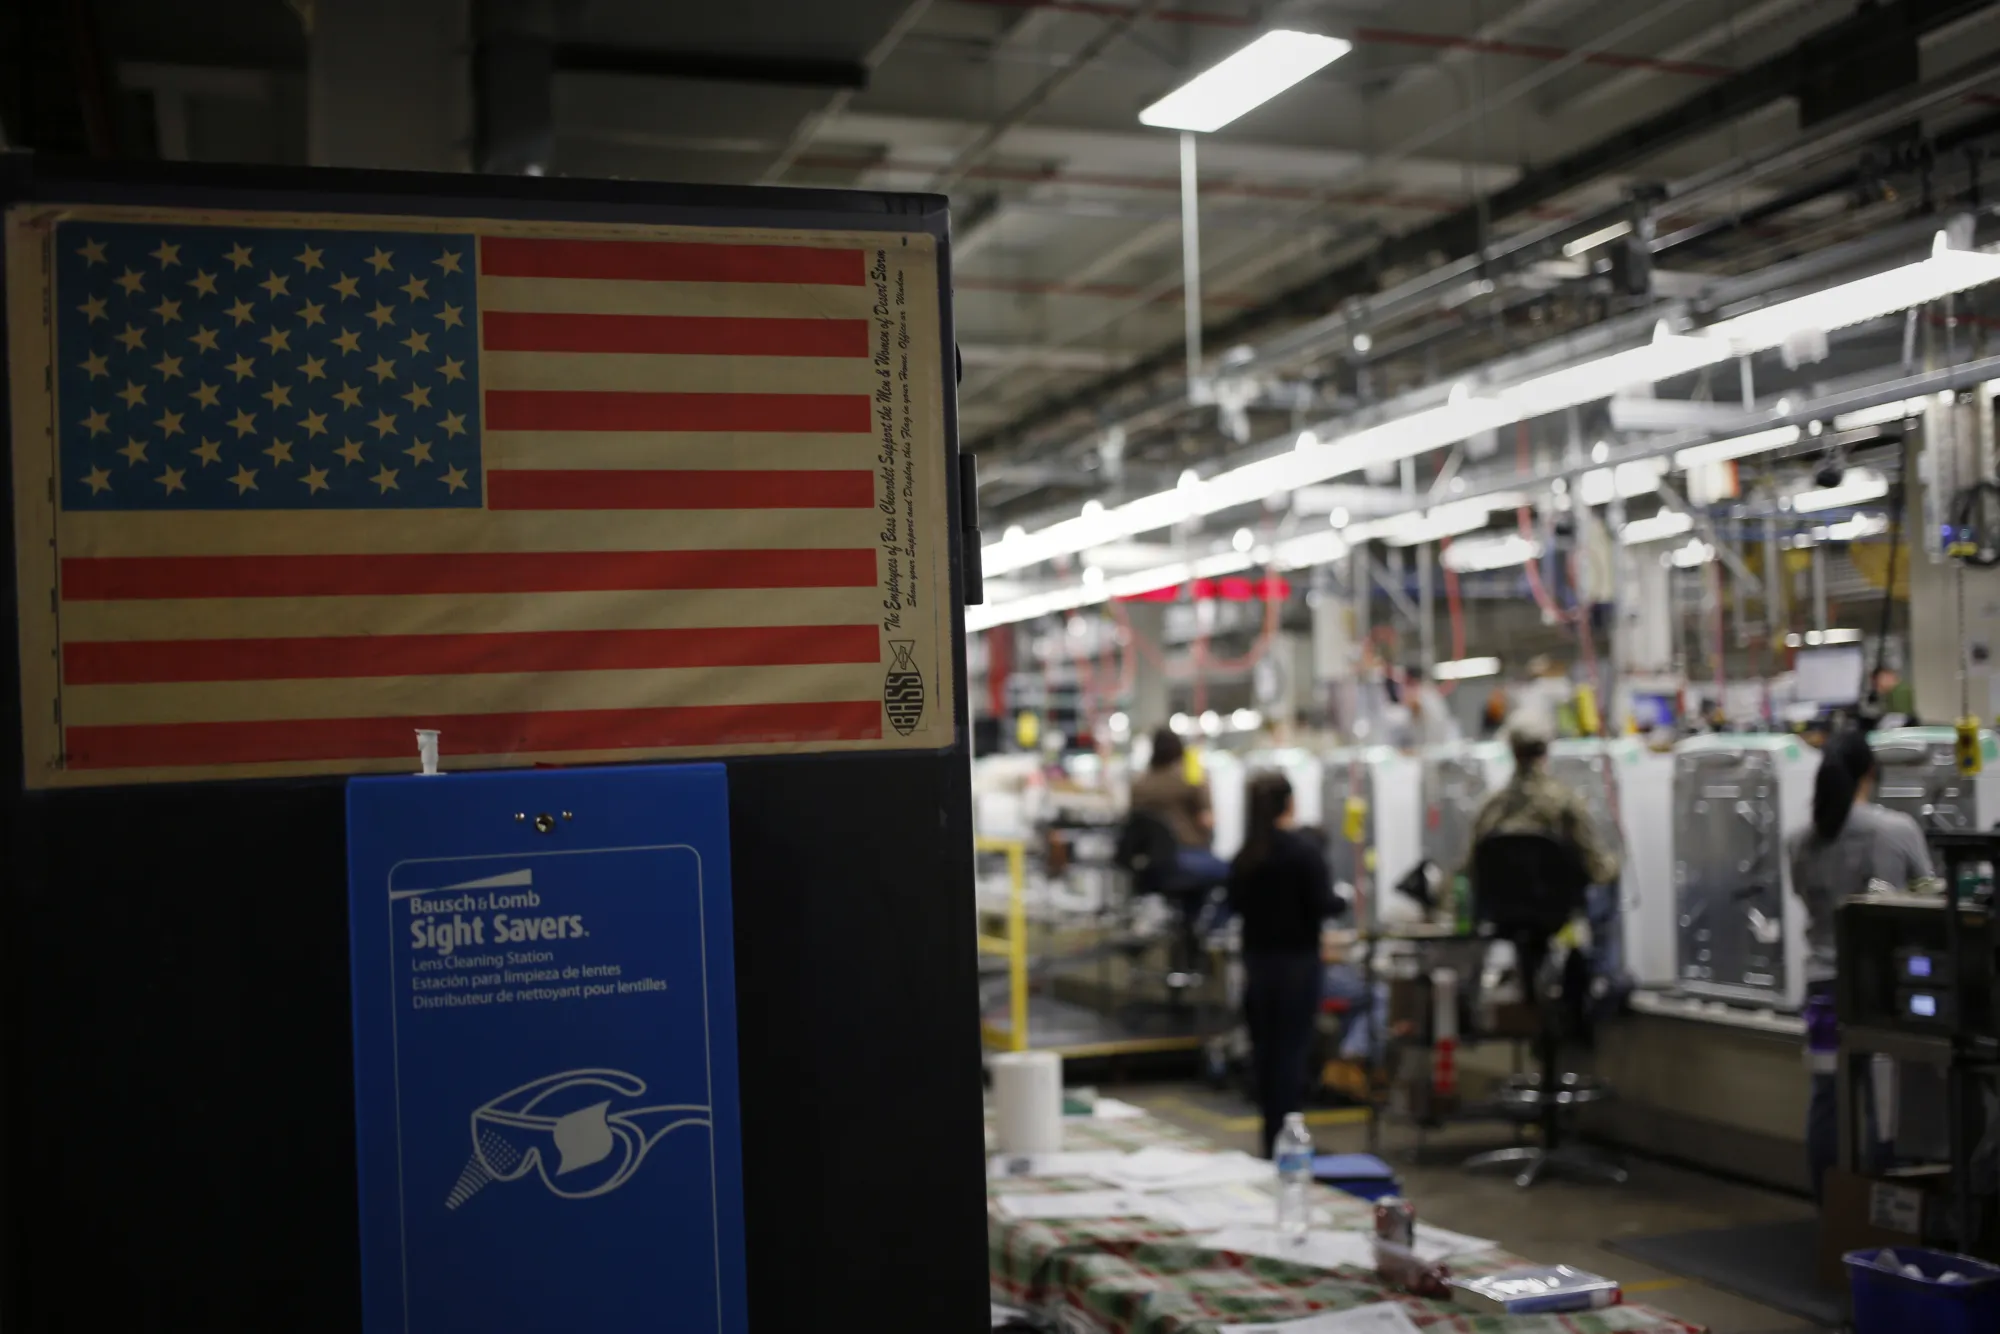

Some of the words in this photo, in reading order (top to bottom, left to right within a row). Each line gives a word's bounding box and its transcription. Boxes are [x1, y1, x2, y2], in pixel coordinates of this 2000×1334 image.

[870, 249, 886, 281] Storm
[873, 283, 889, 315] Desert
[895, 270, 904, 306] Window
[873, 317, 894, 329] of
[899, 311, 906, 321] or
[897, 321, 910, 349] Office
[873, 331, 890, 366] Women
[875, 369, 891, 378] &
[876, 380, 892, 403] Men
[902, 383, 912, 404] your
[877, 406, 892, 420] the
[901, 405, 909, 414] in
[900, 416, 912, 439] Flag
[878, 423, 898, 465] Support
[902, 442, 911, 458] this
[879, 467, 896, 514] Chevrolet
[903, 461, 915, 497] Display
[904, 499, 913, 518] and
[880, 518, 897, 542] Bass
[905, 519, 917, 557] Support
[880, 545, 902, 555] of
[908, 559, 918, 580] your
[883, 559, 902, 610] Employees
[907, 582, 917, 607] Show
[884, 613, 900, 632] The
[885, 675, 923, 726] BASS
[410, 894, 475, 914] Bausch
[490, 890, 541, 910] Lomb
[410, 915, 484, 955] Sight
[412, 957, 443, 972] Lens
[444, 953, 504, 969] Cleaning
[506, 950, 553, 965] Station
[412, 973, 468, 990] Estación
[471, 974, 501, 989] para
[503, 968, 560, 985] limpieza
[562, 966, 580, 979] de
[582, 963, 621, 978] lentes
[412, 992, 494, 1010] Distributeur
[496, 989, 514, 1003] de
[516, 982, 580, 1002] nettoyant
[583, 983, 616, 998] pour
[617, 977, 668, 994] lentilles
